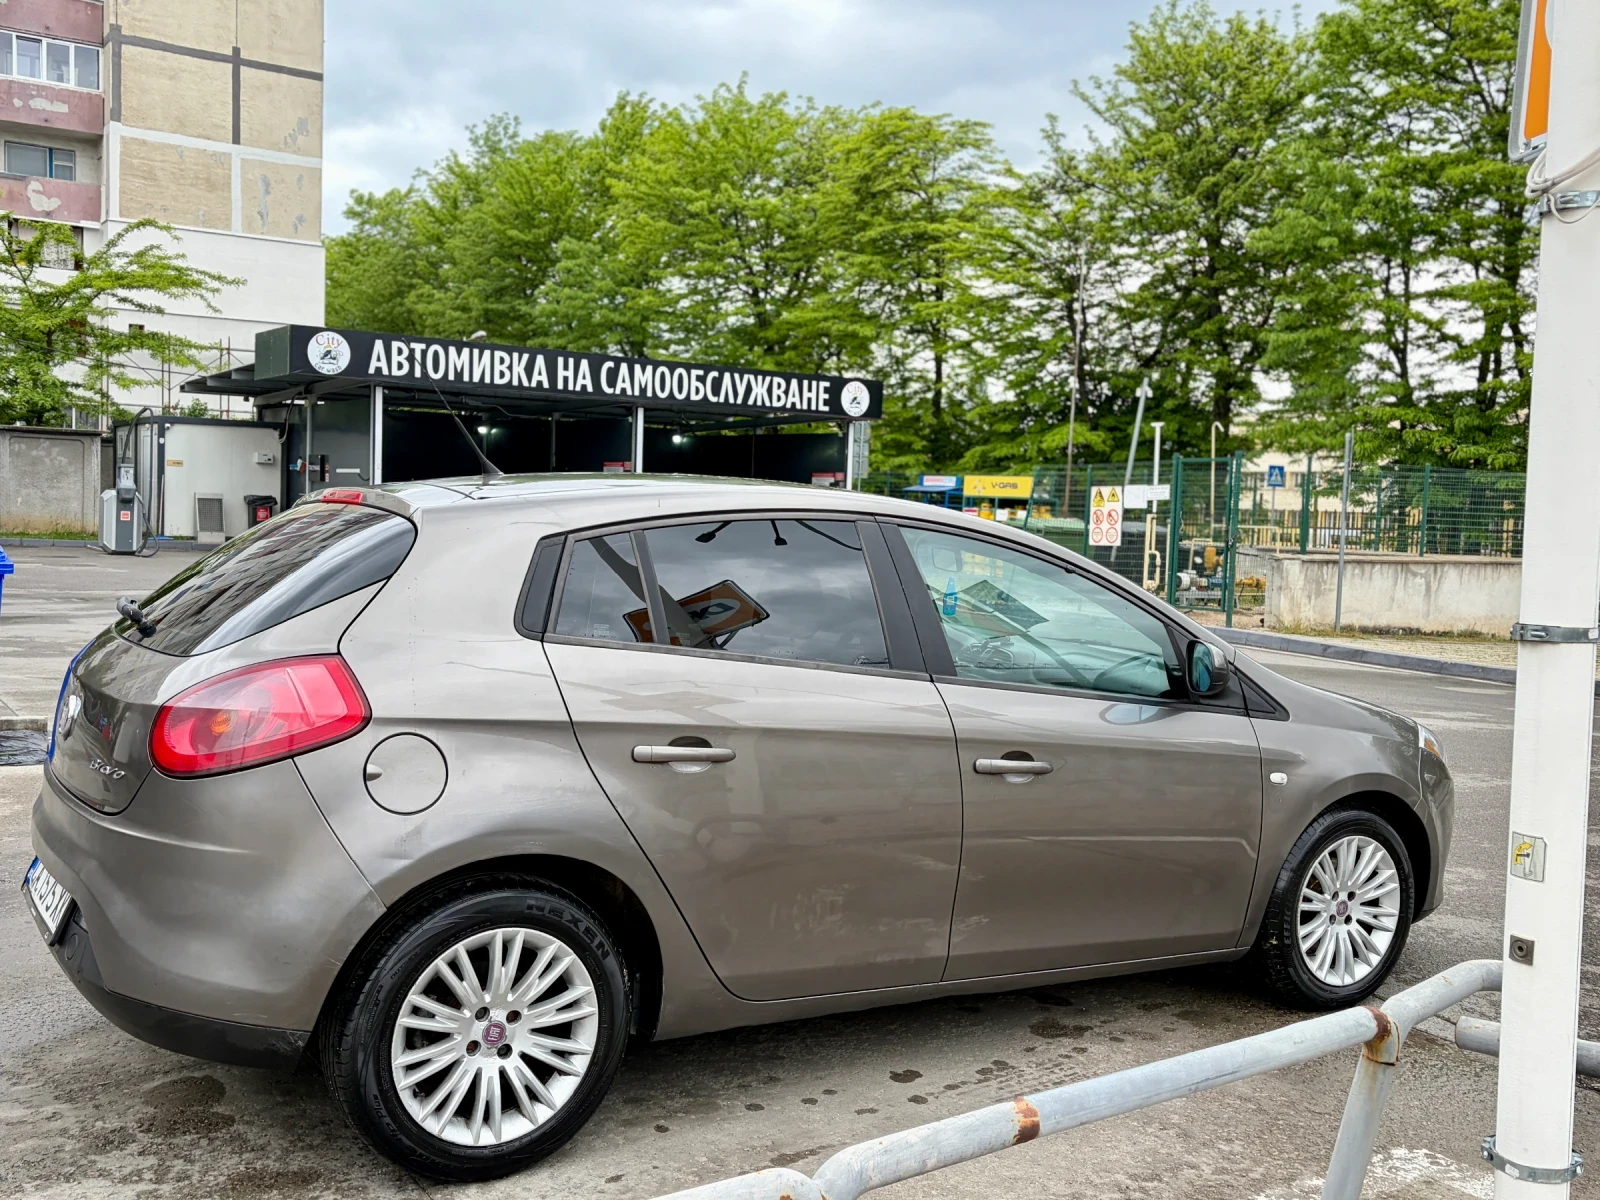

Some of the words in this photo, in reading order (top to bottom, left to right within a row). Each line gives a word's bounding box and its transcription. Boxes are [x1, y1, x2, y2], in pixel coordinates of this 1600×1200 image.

[315, 334, 343, 349] City
[368, 339, 550, 389] АВТОМИВКА
[557, 356, 594, 393] НА
[600, 361, 831, 412] САМООБСЛУЖВАНЕ
[488, 1025, 501, 1041] FIAT
